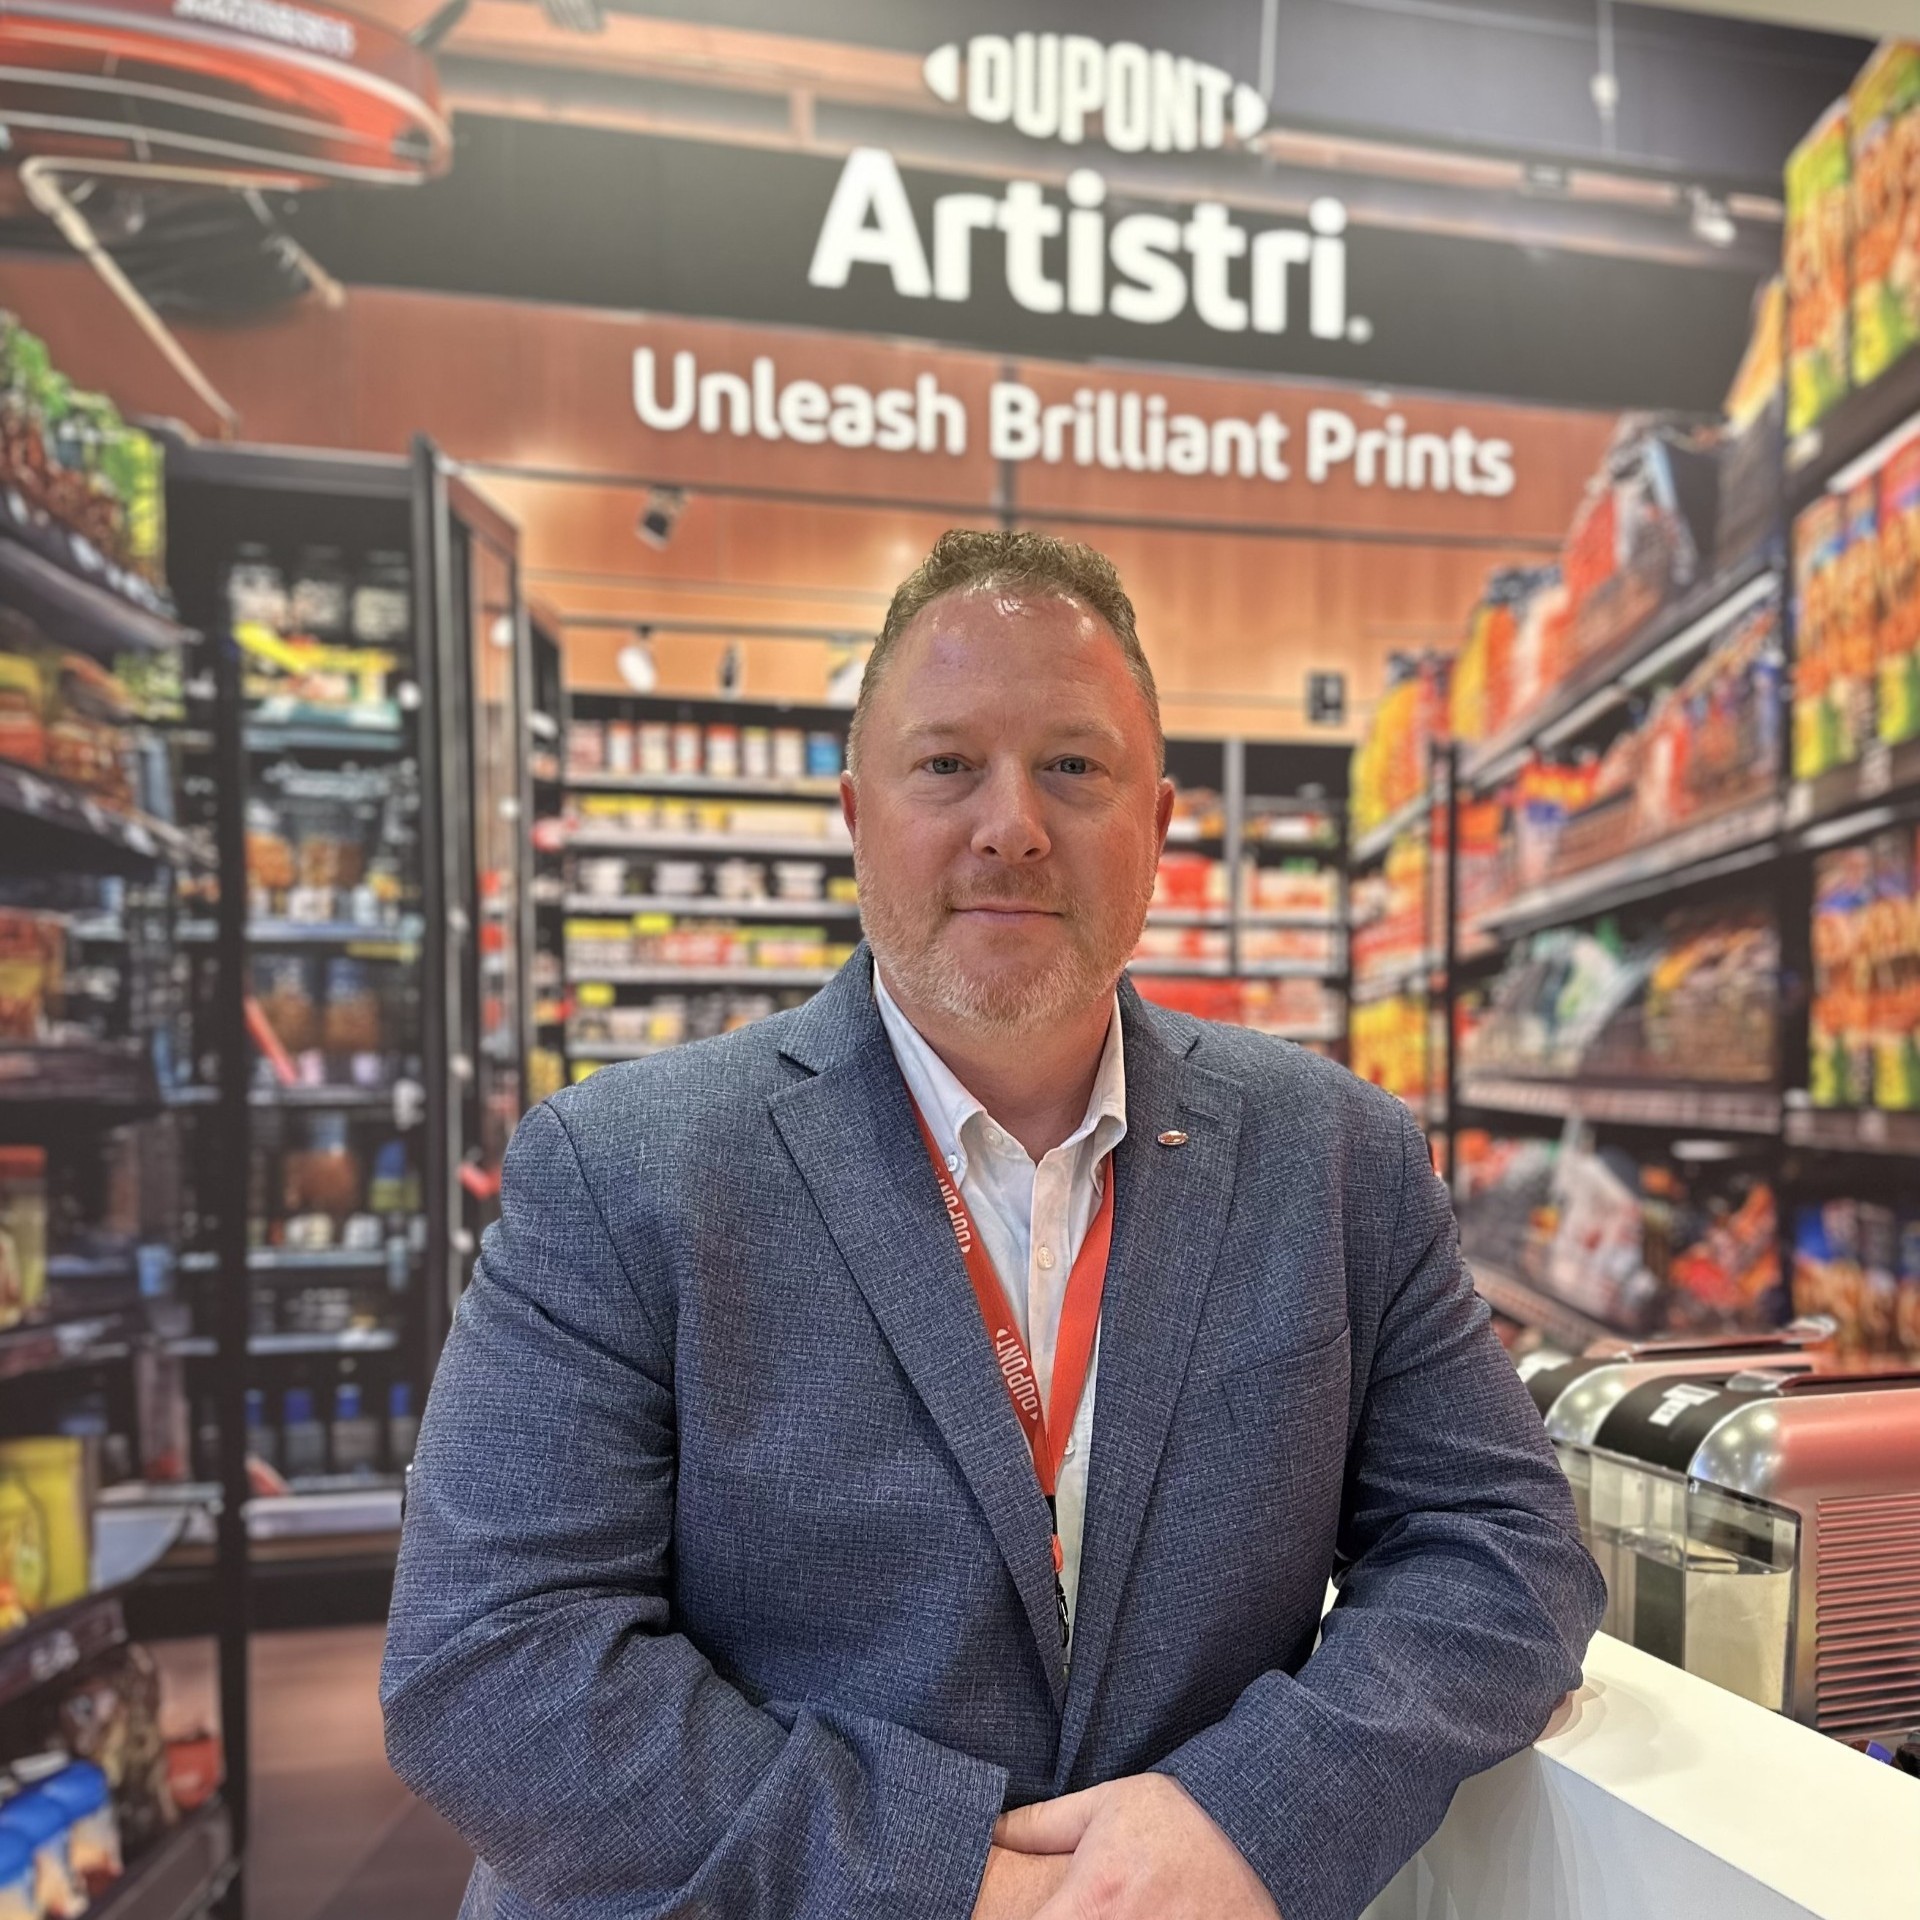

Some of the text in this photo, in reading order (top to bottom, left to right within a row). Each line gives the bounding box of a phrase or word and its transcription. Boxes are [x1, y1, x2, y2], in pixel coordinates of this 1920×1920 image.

[966, 31, 1233, 153] DUPONT
[632, 346, 1516, 497] Unleash Brilliant Prints
[996, 1337, 1038, 1412] DUPONT
